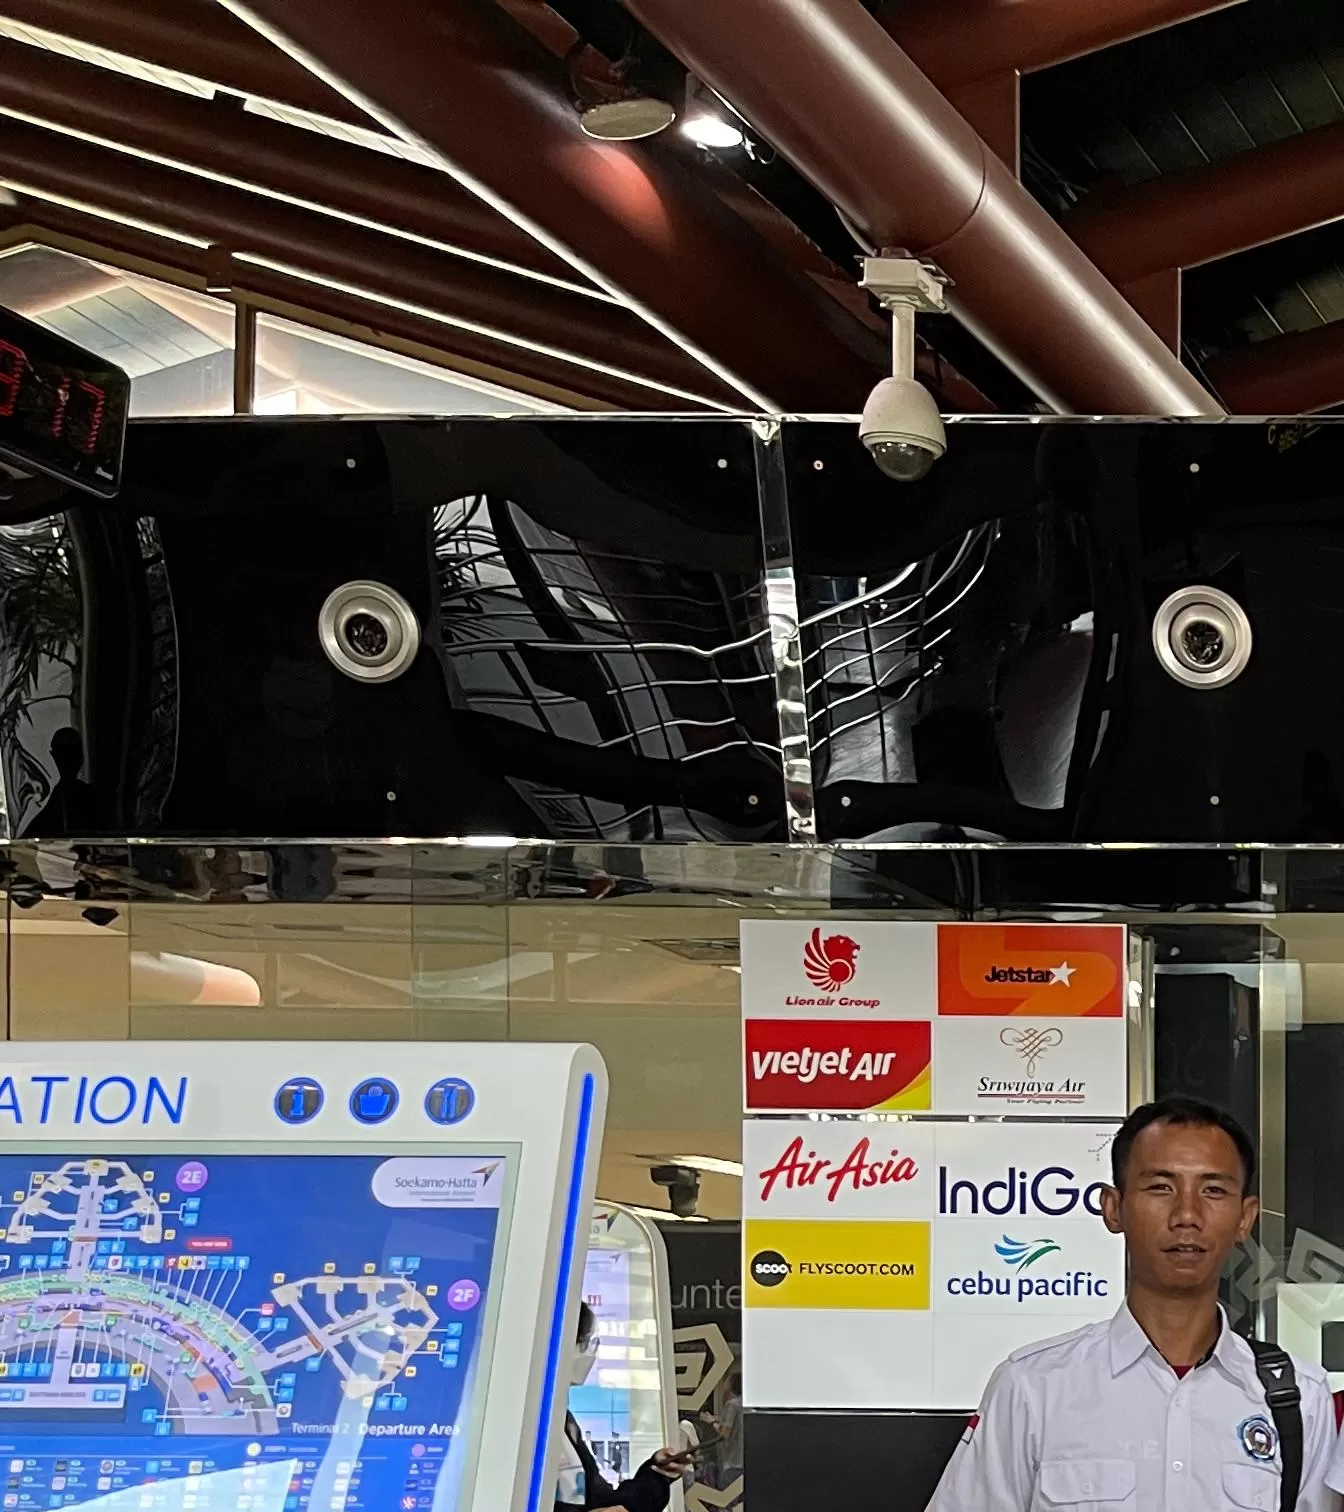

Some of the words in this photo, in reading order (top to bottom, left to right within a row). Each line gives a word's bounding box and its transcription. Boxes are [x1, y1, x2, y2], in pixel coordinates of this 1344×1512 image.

[838, 997, 881, 1009] Group
[977, 1076, 1054, 1096] Sriwijaya
[1058, 1077, 1086, 1092] Air
[799, 1263, 914, 1276] FLYSCOOT.COM
[947, 1270, 1011, 1296] cebu
[1017, 1271, 1108, 1303] pacific
[359, 1423, 426, 1436] Departure
[428, 1424, 460, 1436] Area
